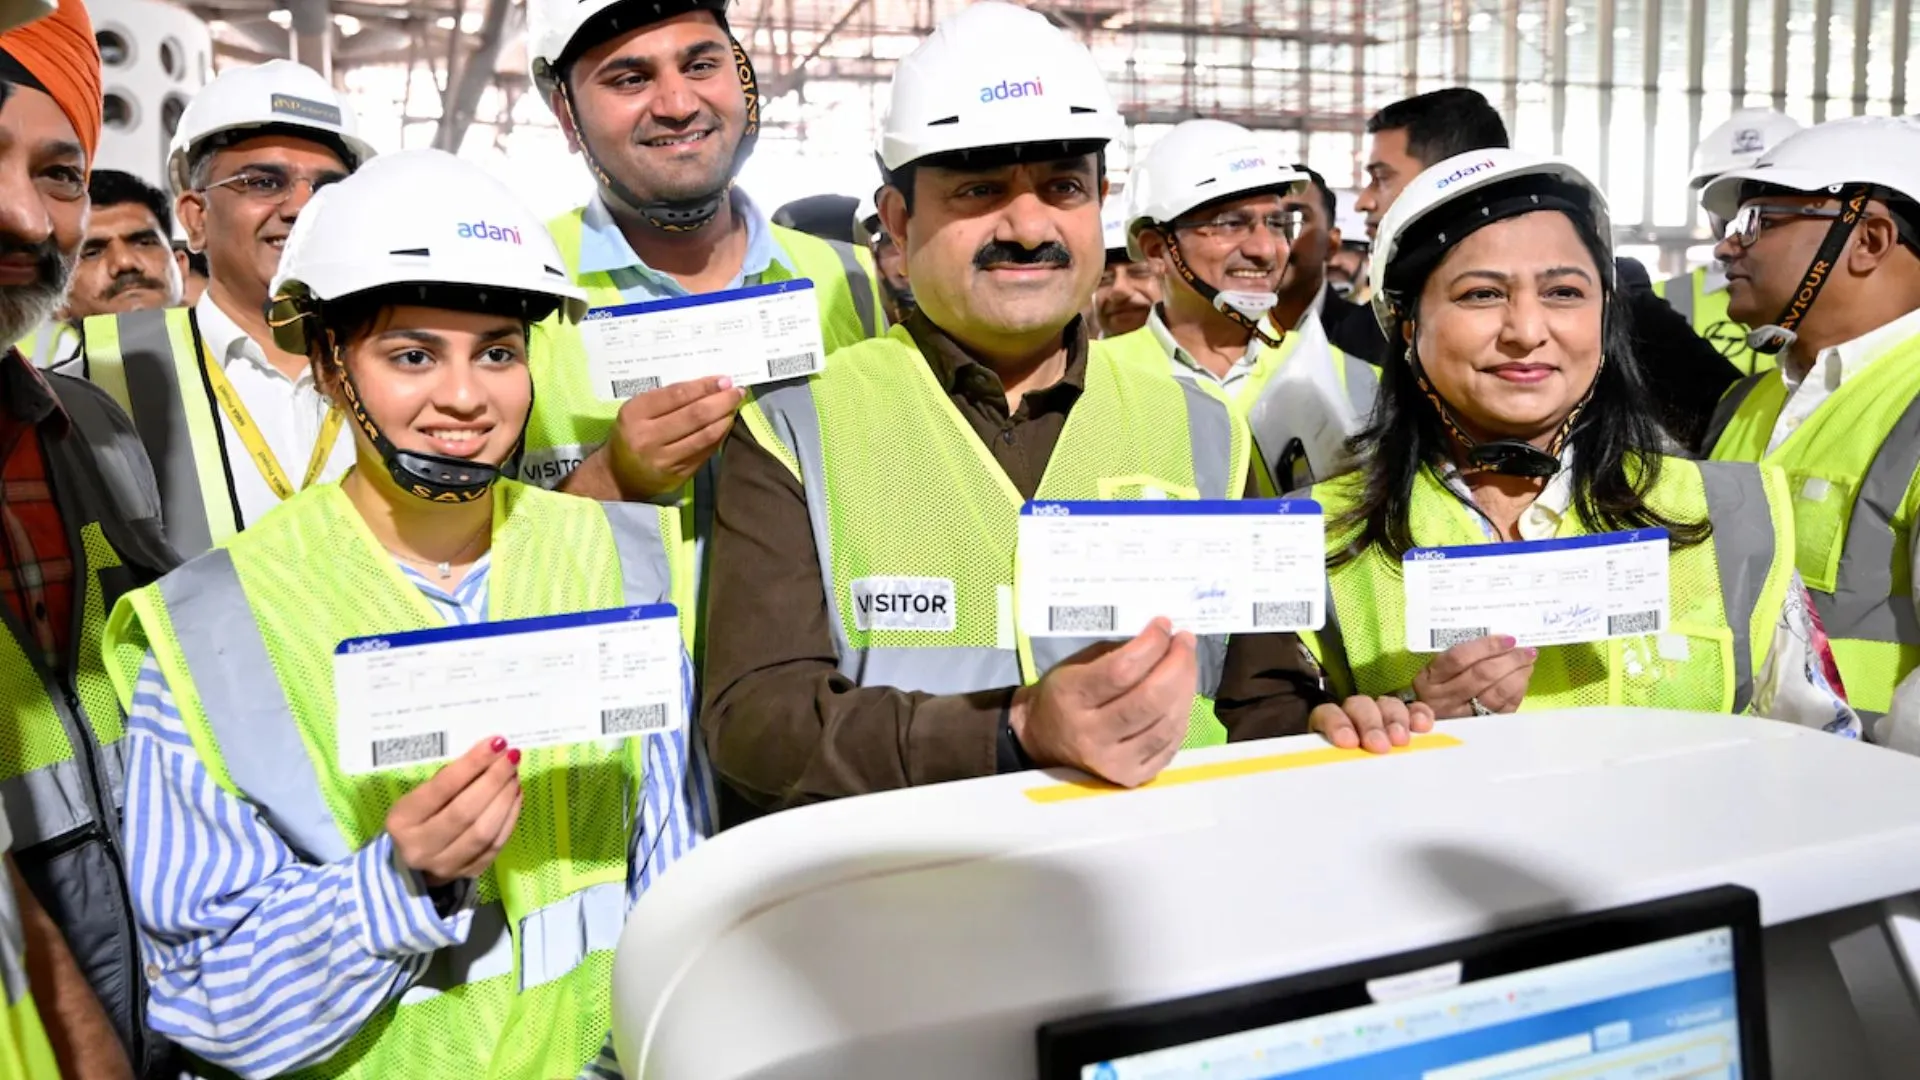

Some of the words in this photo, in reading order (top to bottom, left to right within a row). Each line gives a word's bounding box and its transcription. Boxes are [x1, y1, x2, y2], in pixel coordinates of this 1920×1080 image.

[979, 76, 1043, 103] adani
[1435, 158, 1496, 189] adani
[457, 220, 523, 245] adani
[1031, 504, 1070, 517] IndiGo
[857, 593, 947, 614] VISITOR
